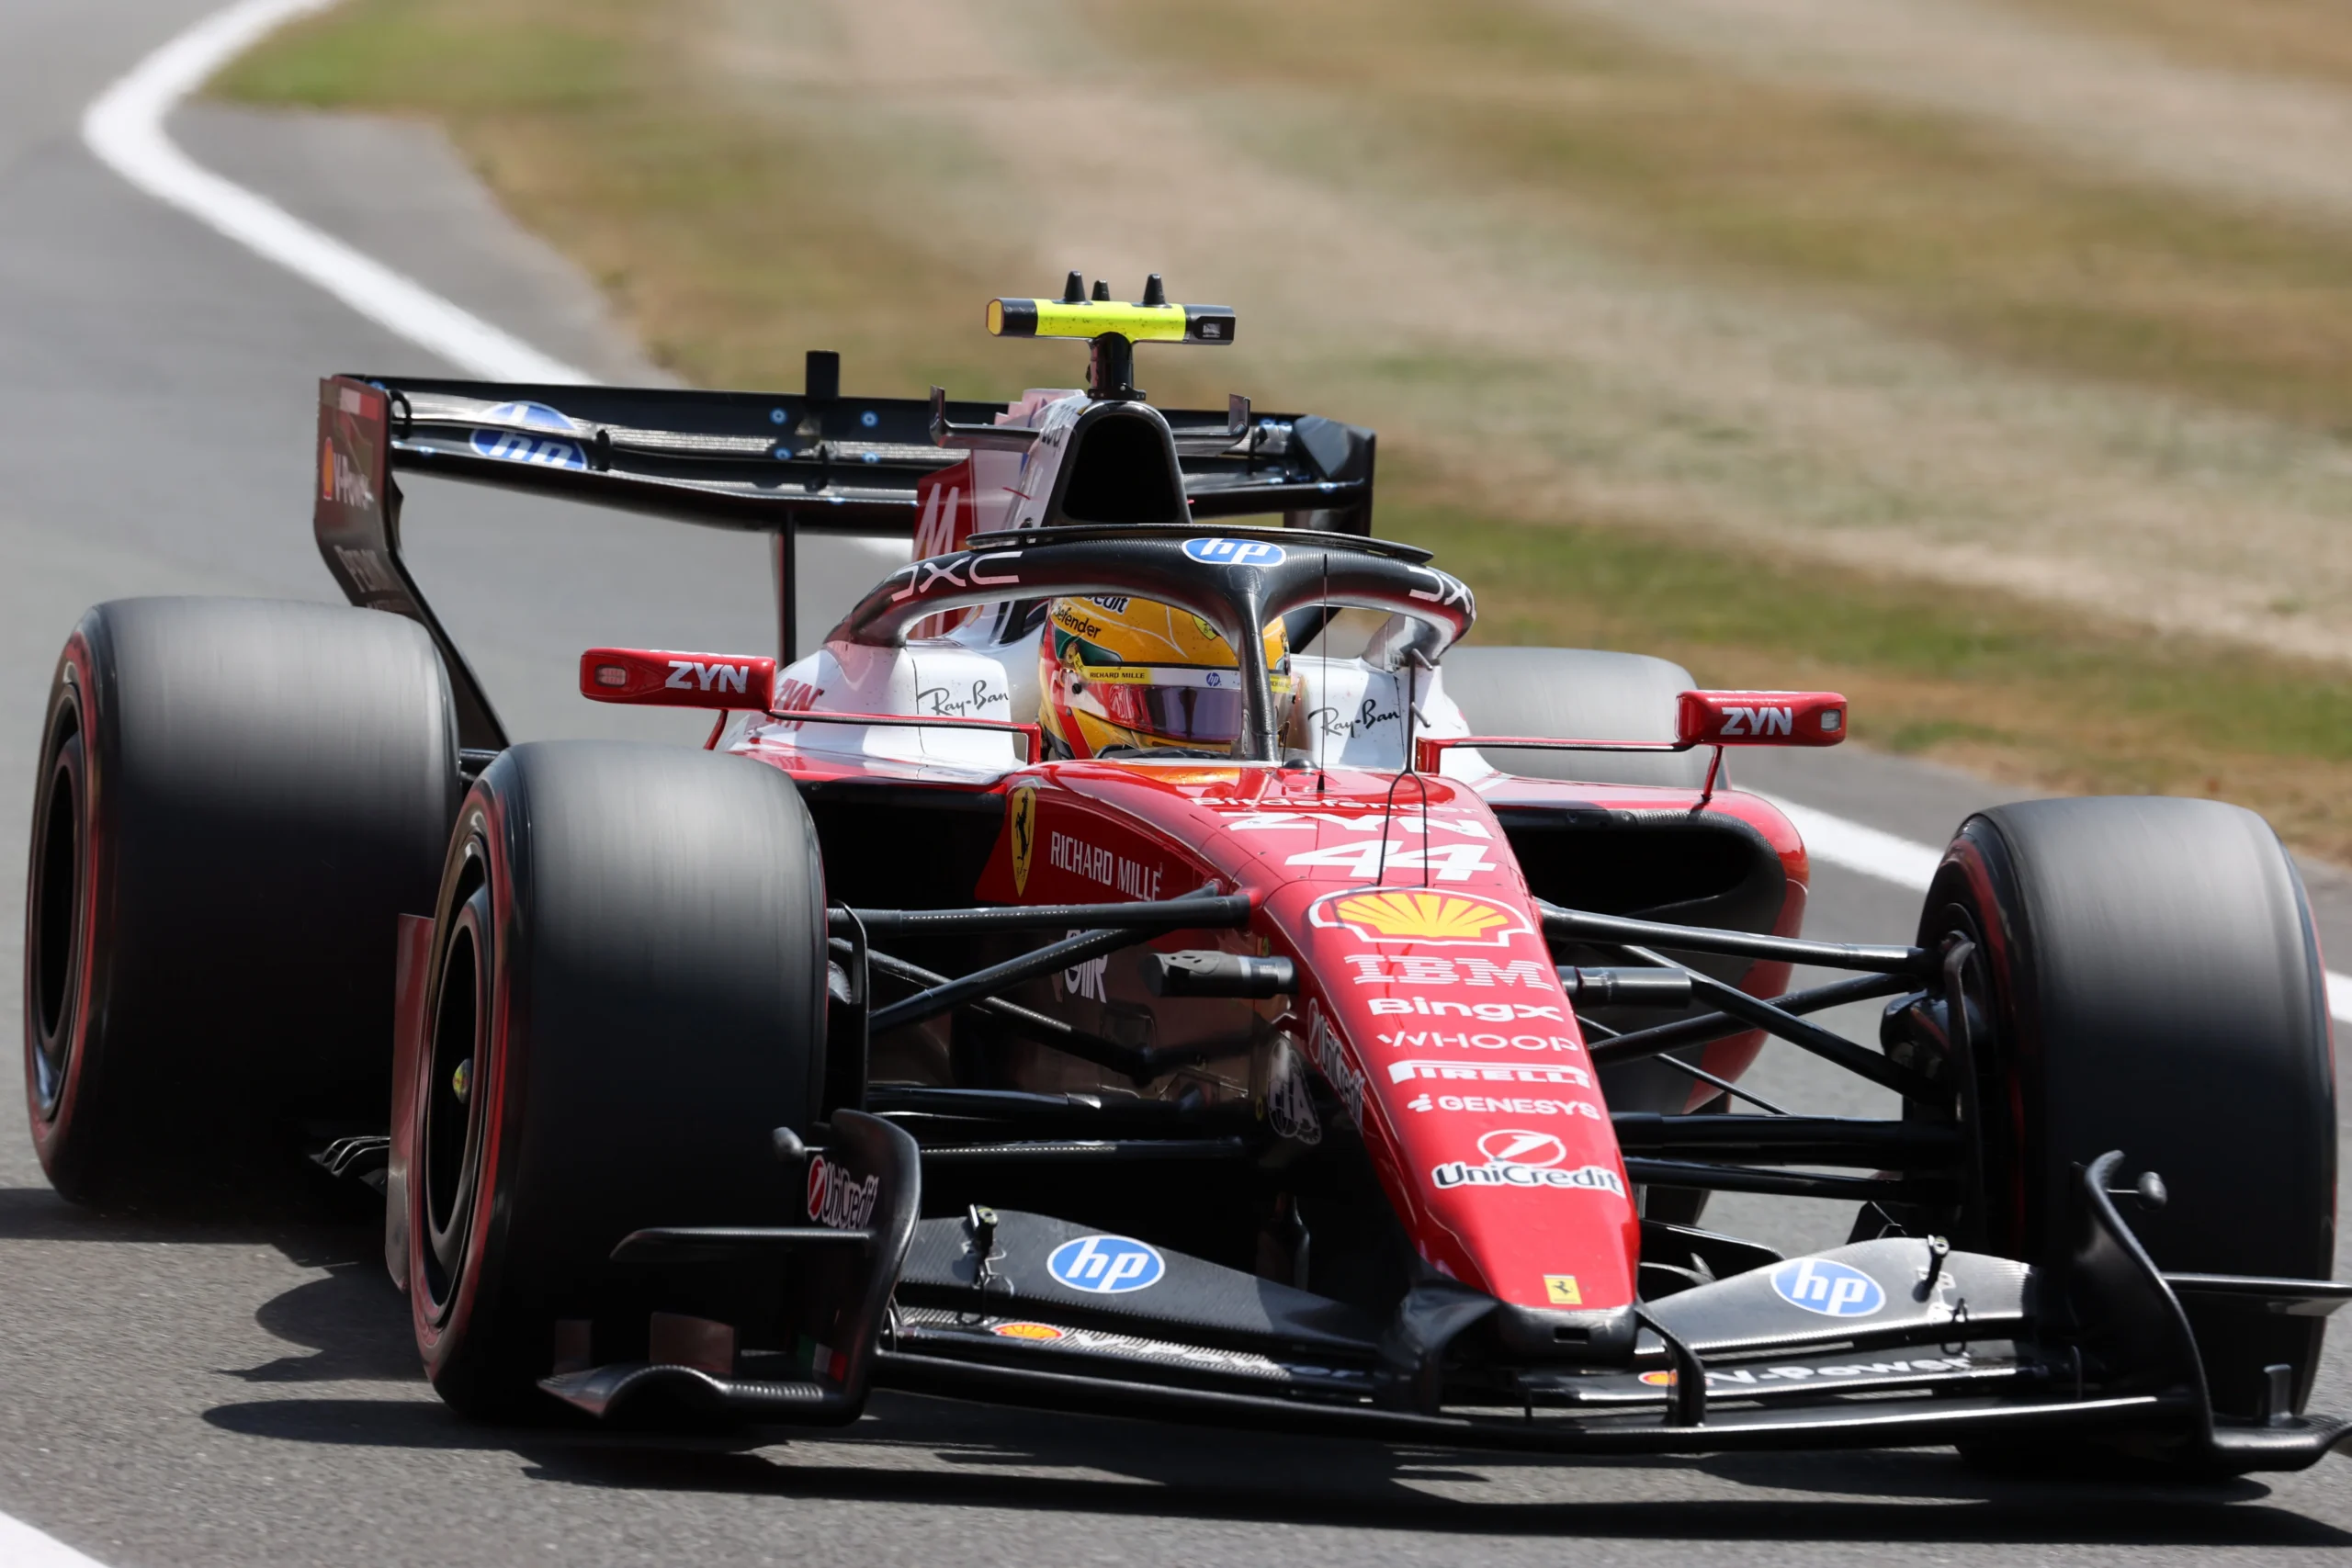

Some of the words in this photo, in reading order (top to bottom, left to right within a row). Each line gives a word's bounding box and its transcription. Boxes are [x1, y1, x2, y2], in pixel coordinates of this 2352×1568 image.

[1200, 538, 1271, 564] hp
[891, 551, 1023, 602] DXC
[664, 660, 750, 694] ZYN
[1207, 672, 1219, 686] hp
[916, 680, 1009, 716] Ray-Ban
[1307, 699, 1400, 738] Ray-Ban
[1720, 706, 1792, 735] ZYN
[1190, 796, 1479, 815] Bitdefender
[1221, 812, 1495, 840] ZYN
[1050, 831, 1114, 886] RICHARD
[1284, 840, 1497, 881] 44
[1344, 953, 1555, 991] IBM
[1376, 1031, 1578, 1052] WHOOP
[1388, 1059, 1591, 1089] PIRELLI
[1438, 1095, 1602, 1121] GENESYS
[1435, 1158, 1623, 1194] UniCredit
[1067, 1240, 1148, 1292] hp
[1792, 1258, 1869, 1314] hp
